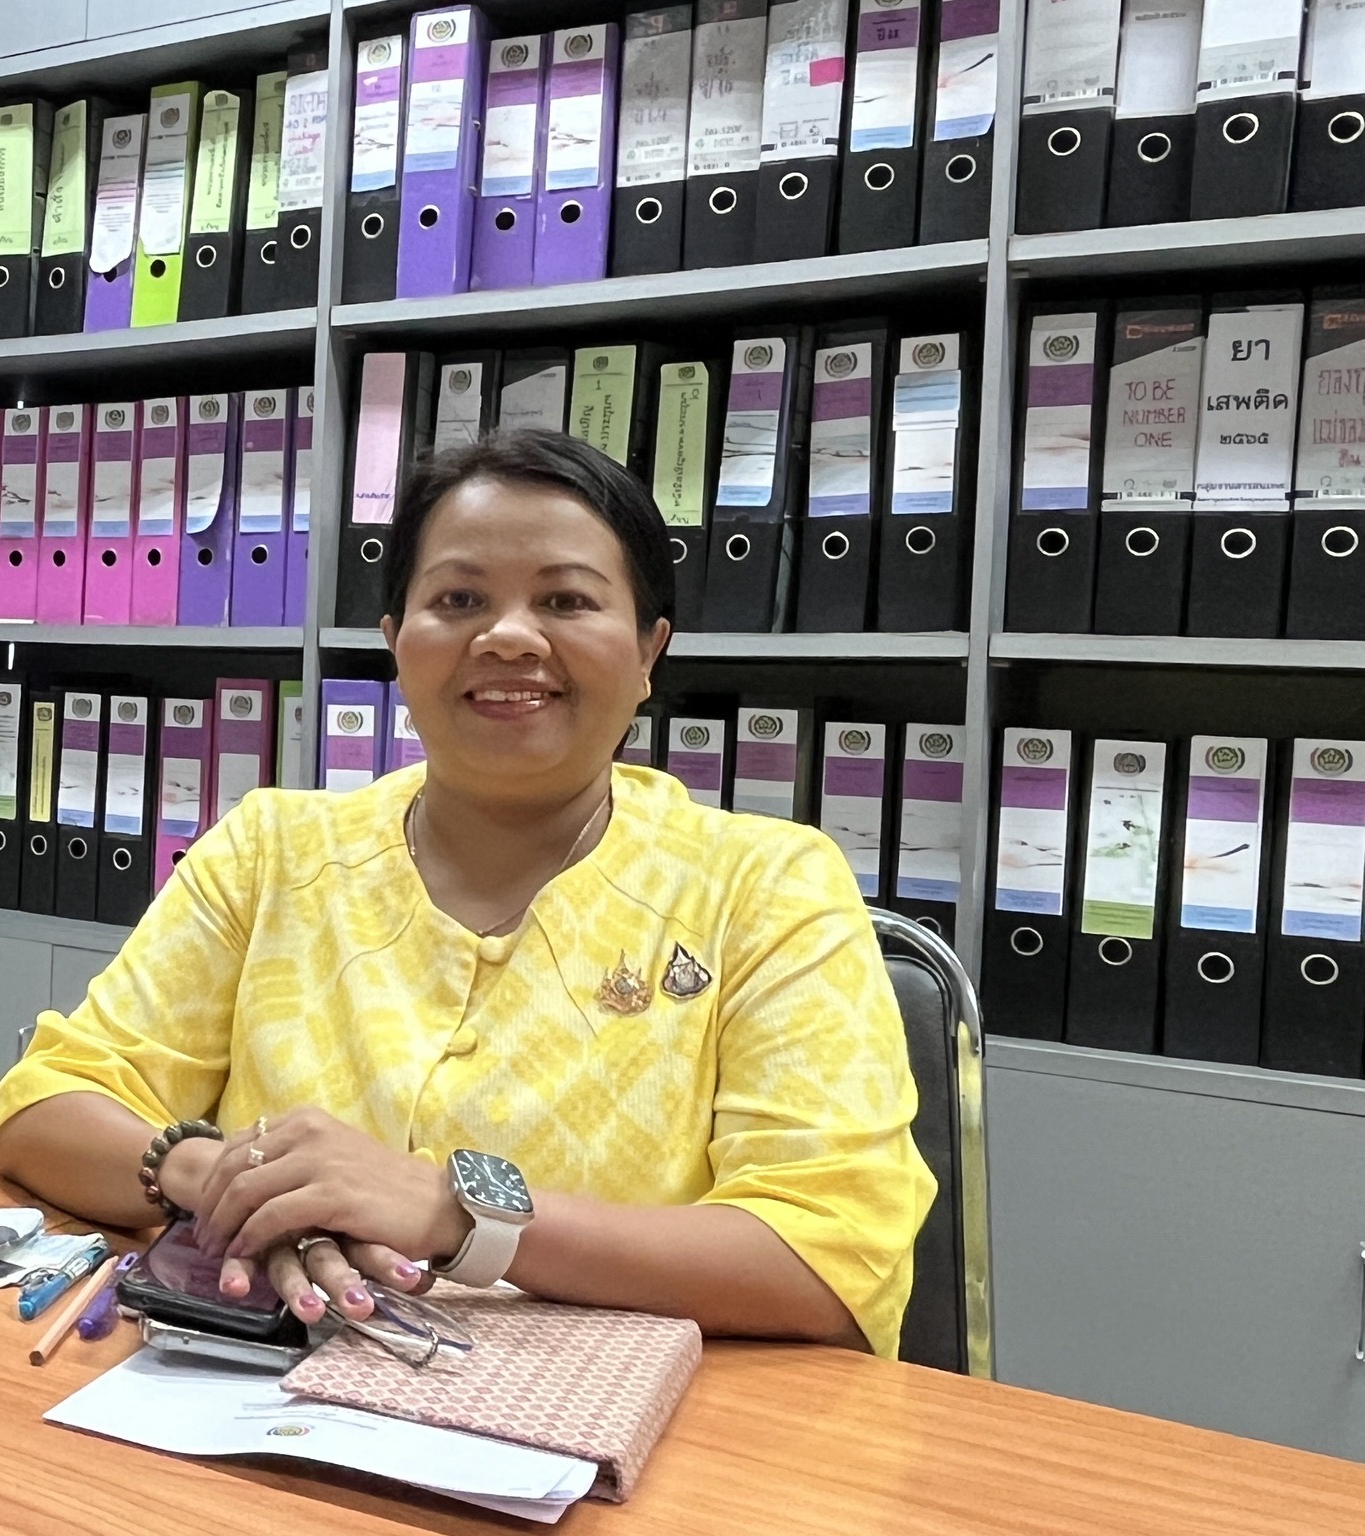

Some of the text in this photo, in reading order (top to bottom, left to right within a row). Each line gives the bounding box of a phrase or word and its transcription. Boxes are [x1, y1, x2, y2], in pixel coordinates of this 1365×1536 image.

[1230, 338, 1271, 361] ยา
[1125, 378, 1176, 400] TO BE
[1206, 388, 1289, 411] เสพติด
[1123, 406, 1186, 425] NUMBER
[1134, 431, 1173, 448] ONE
